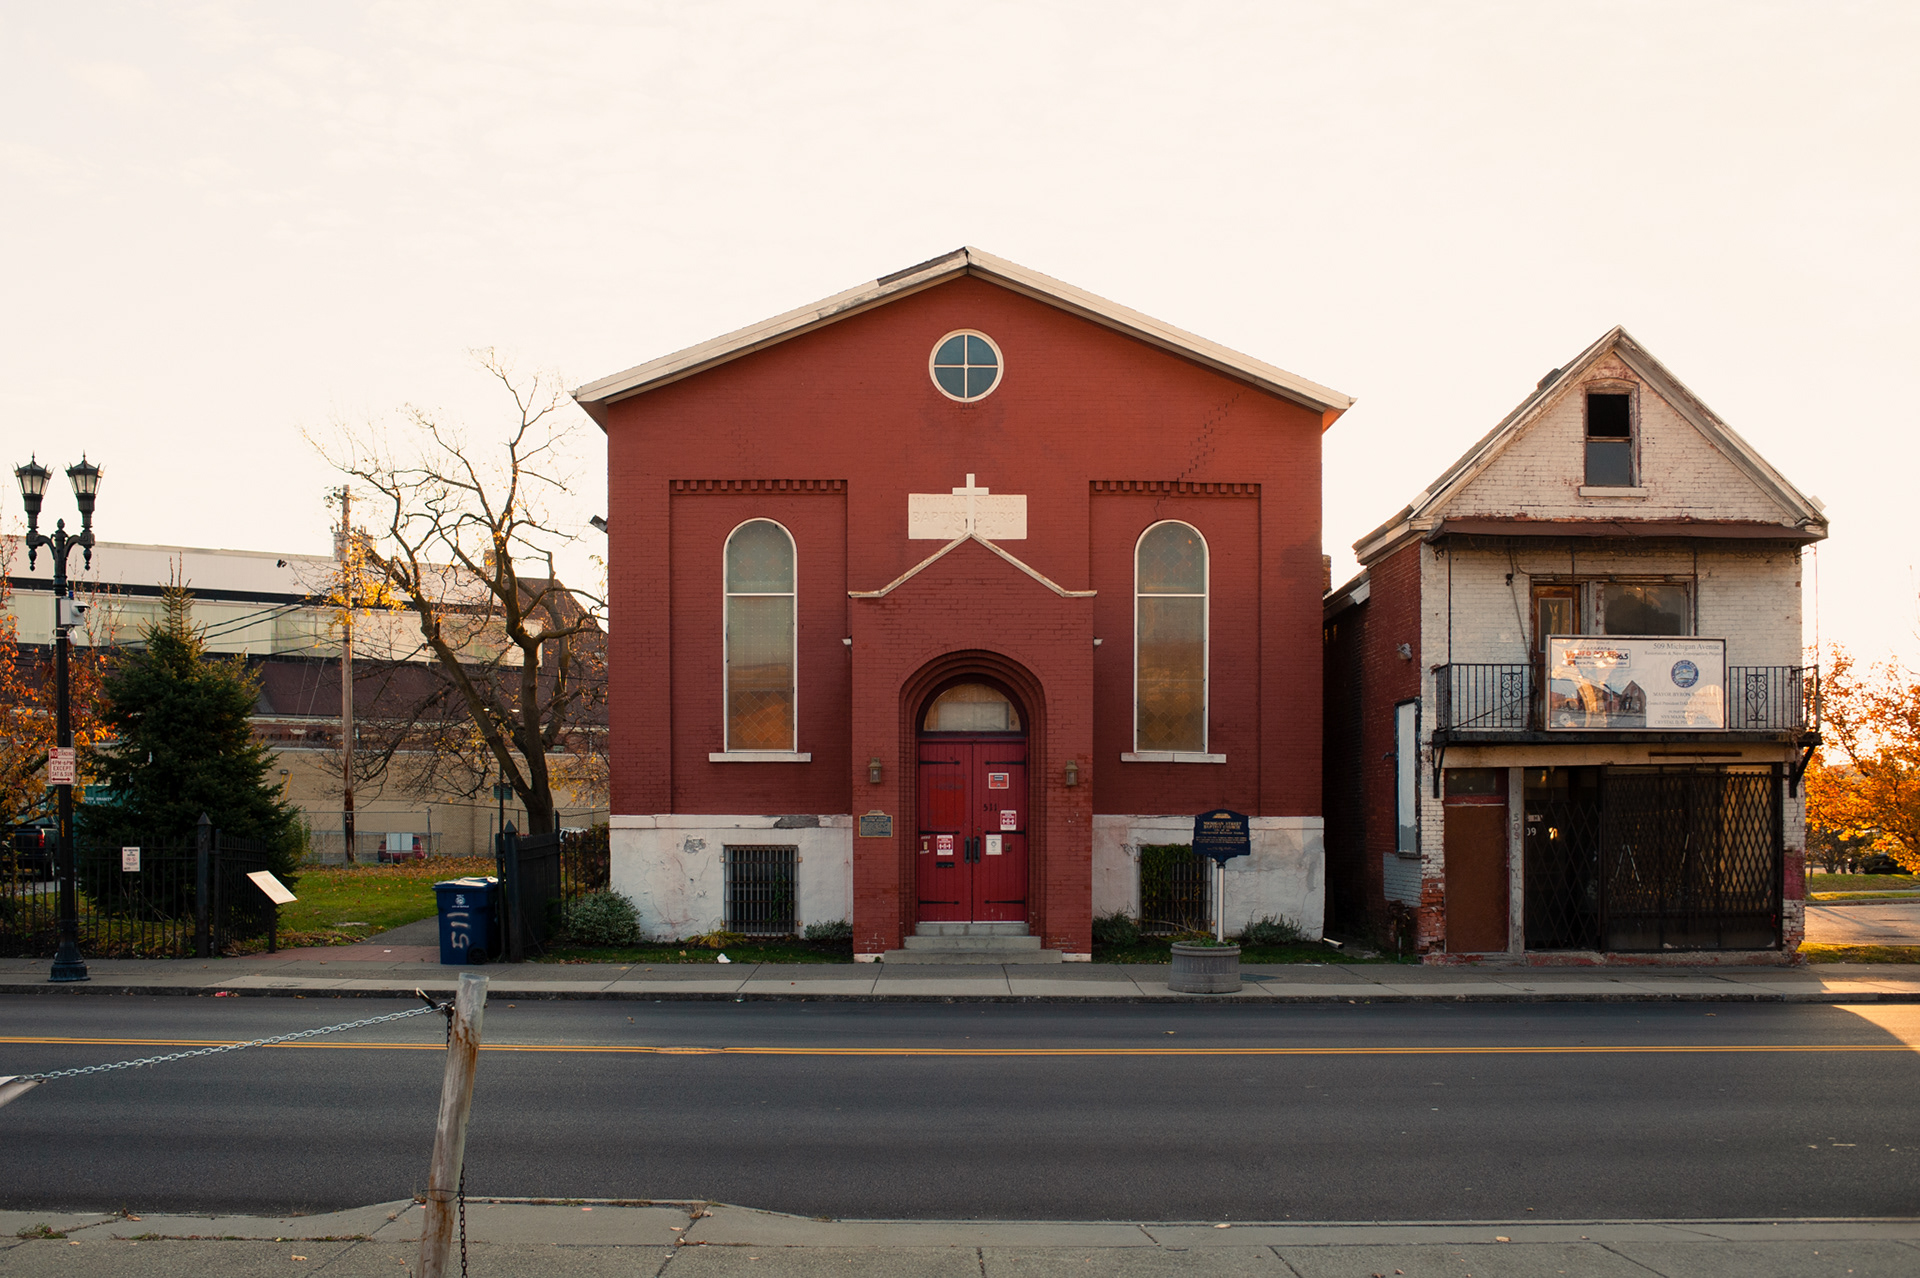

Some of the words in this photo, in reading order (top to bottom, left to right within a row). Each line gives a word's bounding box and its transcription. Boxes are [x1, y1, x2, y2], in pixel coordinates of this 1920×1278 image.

[912, 511, 967, 523] BAPTIST
[1666, 643, 1696, 651] Michigan
[983, 803, 998, 812] 511
[446, 912, 470, 948] 511
